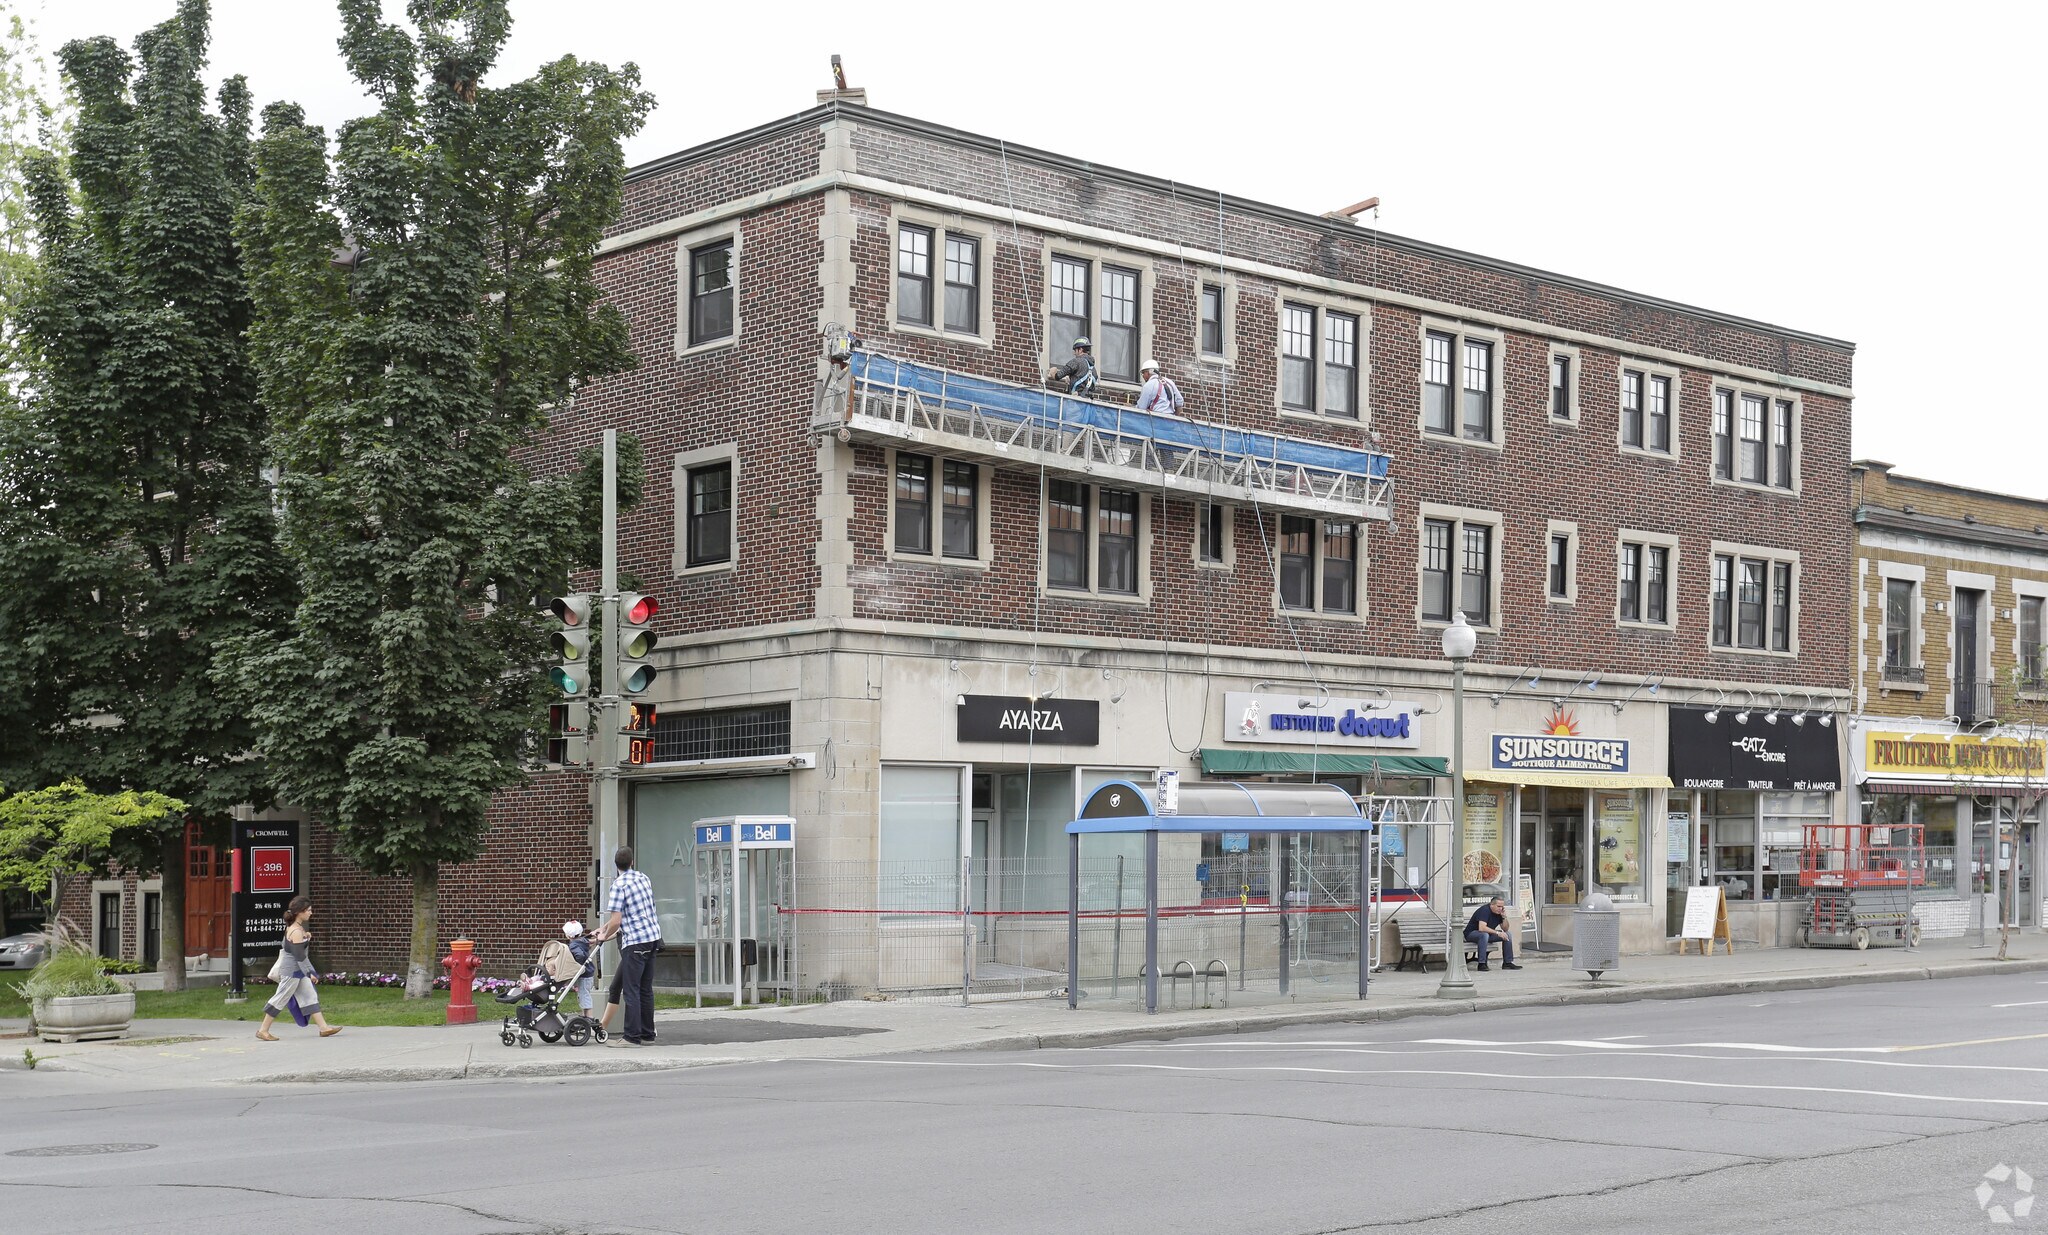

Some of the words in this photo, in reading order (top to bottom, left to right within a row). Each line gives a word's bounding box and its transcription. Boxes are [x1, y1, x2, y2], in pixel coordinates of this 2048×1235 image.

[999, 709, 1063, 731] AYARZA
[1270, 713, 1336, 732] NETTOYEUR
[1339, 708, 1410, 739] daoust
[1739, 736, 1767, 752] EATZ
[1499, 737, 1624, 767] SUNSOURCE
[1759, 751, 1786, 762] ENCORE
[1873, 739, 1950, 767] FRUITERIE
[1954, 743, 1990, 768] MONT
[1993, 745, 2044, 770] VICTORIA
[1511, 759, 1555, 768] BOUTIQUE
[1555, 760, 1612, 770] ALIMENTAIRE
[1684, 778, 1724, 789] BOULANGERIE
[1748, 780, 1774, 789] TRAITEUR
[1793, 780, 1806, 790] PRÊT
[1806, 779, 1812, 790] À
[1812, 781, 1836, 790] MANGER
[706, 826, 722, 842] Bell
[754, 825, 777, 840] Bell
[263, 862, 283, 872] 396
[245, 925, 286, 933] 514-844-727
